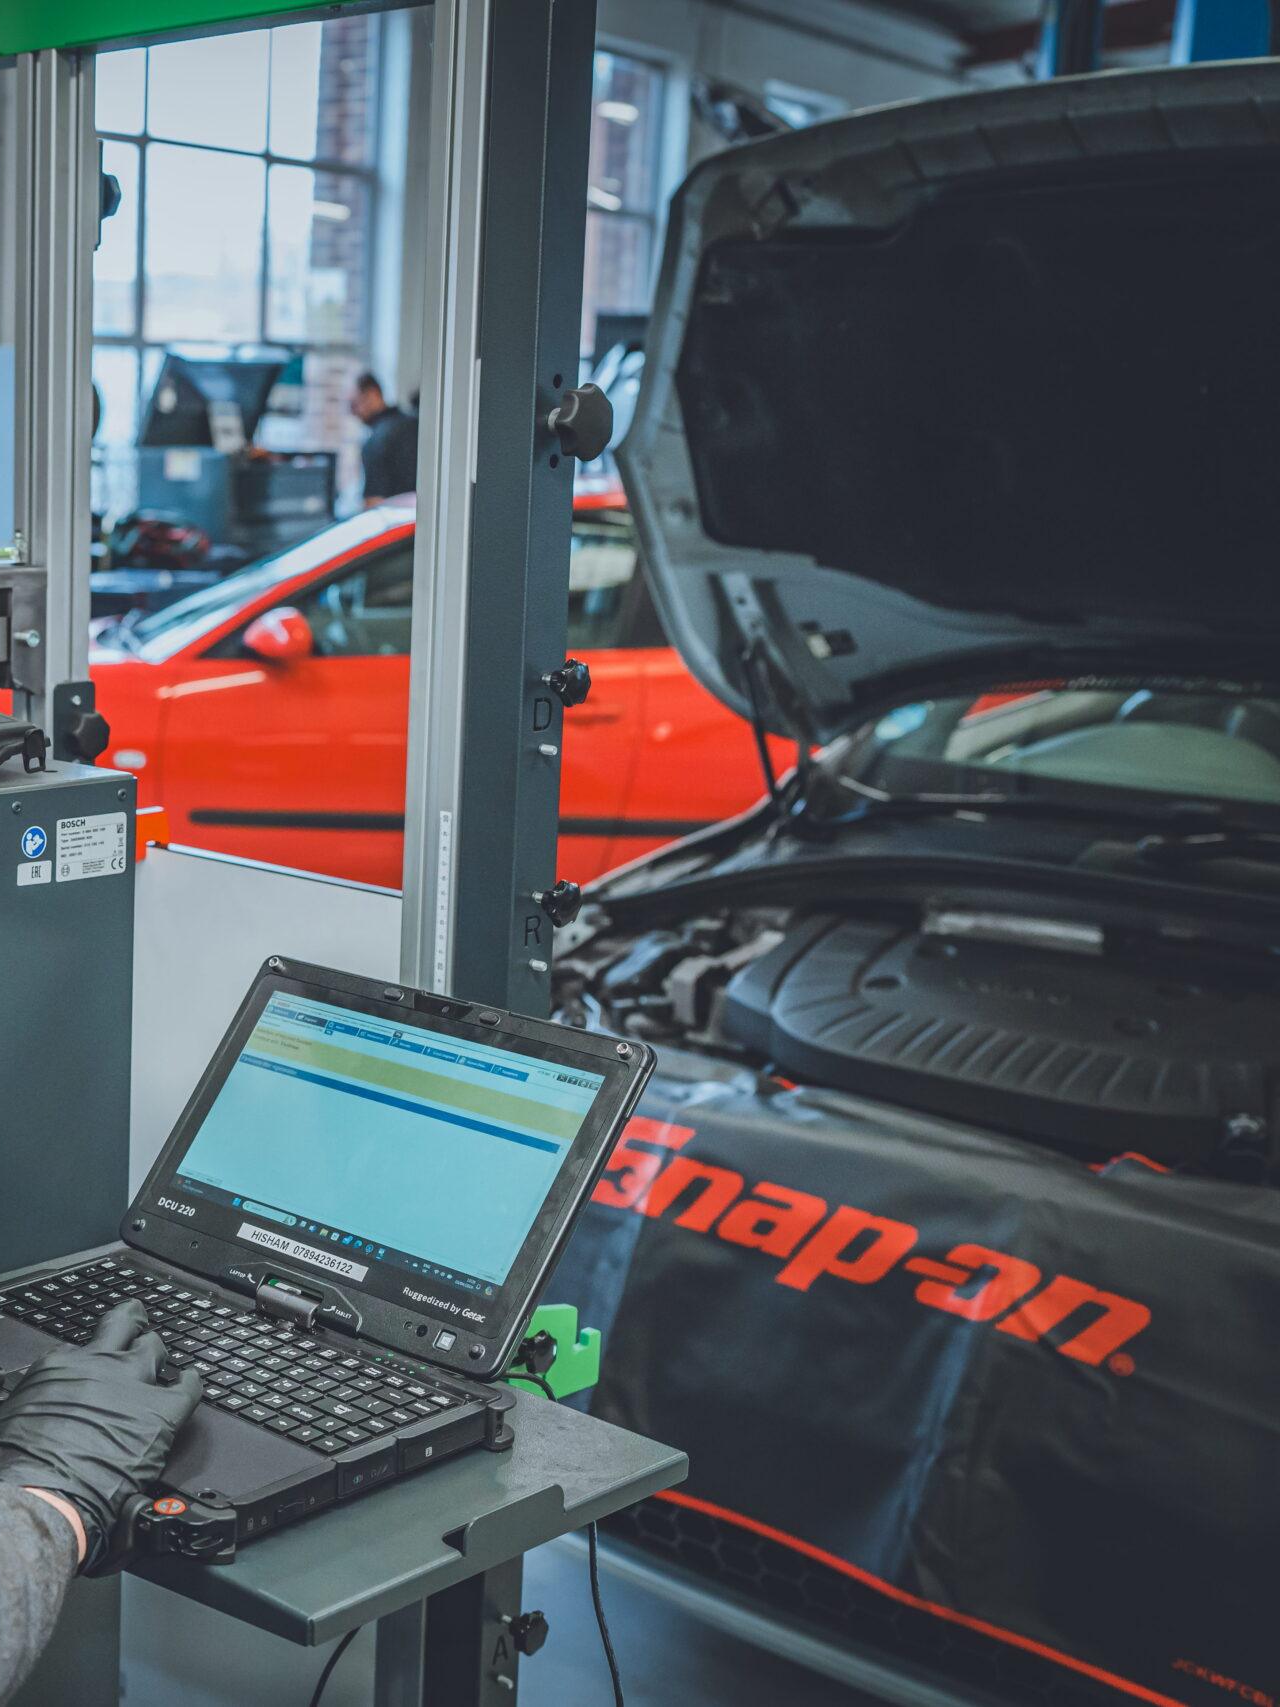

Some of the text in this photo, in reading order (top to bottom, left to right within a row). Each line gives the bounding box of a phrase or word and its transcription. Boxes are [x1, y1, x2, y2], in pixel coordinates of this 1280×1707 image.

[533, 697, 552, 731] D
[60, 819, 86, 829] BOSCH
[524, 915, 541, 946] R
[158, 1197, 196, 1217] DCU 220
[251, 1230, 353, 1274] HISHAM 07894236122
[590, 1115, 1151, 1367] Snap-on
[229, 1268, 246, 1279] LAPTOP
[335, 1308, 353, 1319] TABLET
[402, 1286, 486, 1323] Ruggedized by Getac
[492, 1635, 509, 1666] A
